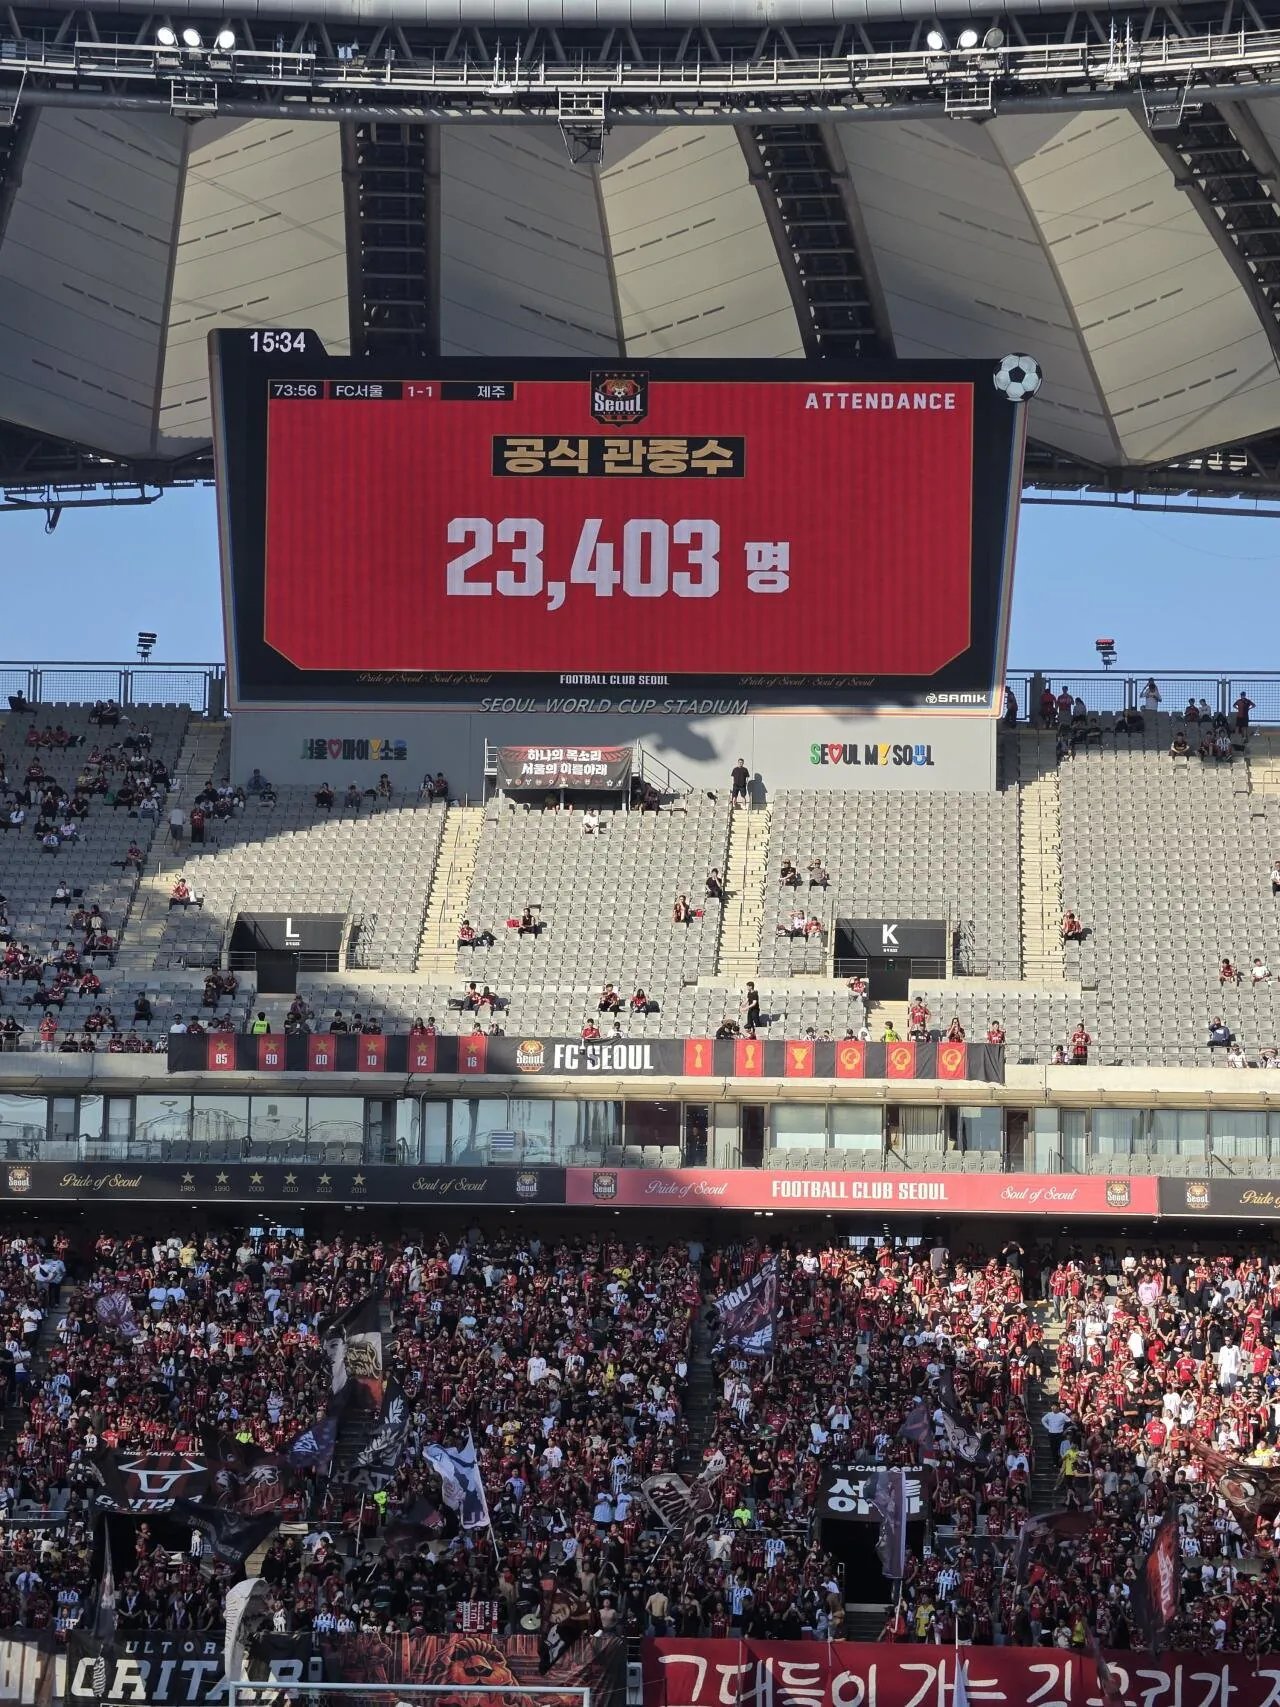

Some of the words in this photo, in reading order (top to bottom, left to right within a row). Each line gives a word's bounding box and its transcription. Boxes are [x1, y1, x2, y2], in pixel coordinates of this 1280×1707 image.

[250, 331, 306, 353] 15:34
[274, 384, 317, 398] 73:56
[335, 384, 384, 399] FC서울
[408, 386, 434, 398] 1-1
[477, 384, 506, 399] 제주
[805, 393, 956, 410] ATTENDANCE
[503, 438, 589, 474] 공식
[602, 439, 734, 475] 관중수
[446, 517, 721, 611] 23,403
[744, 541, 790, 593] 명
[560, 674, 608, 686] FOOTBALL
[610, 675, 636, 686] CLUB
[638, 675, 670, 686] SEOUL
[479, 698, 537, 713] SEOUL
[545, 698, 611, 714] WORLD
[617, 699, 657, 714] CUP
[661, 700, 749, 715] STADIUM
[938, 694, 987, 704] SAMIK
[527, 749, 563, 761] 하나의
[566, 749, 602, 761] 목소리
[521, 763, 557, 775] 서울의
[286, 918, 300, 938] L
[882, 924, 899, 945] K
[216, 1053, 228, 1065] 85
[265, 1053, 278, 1065] 90
[316, 1054, 328, 1065] 00
[367, 1055, 378, 1066] 10
[417, 1055, 427, 1067] 12
[467, 1056, 477, 1067] 16
[553, 1044, 579, 1069] FC
[587, 1044, 654, 1070] SEOUL
[59, 1172, 93, 1187] Pride
[93, 1175, 106, 1190] of
[109, 1173, 142, 1187] Seoul
[412, 1177, 438, 1191] Soul
[440, 1178, 453, 1194] of
[454, 1177, 487, 1191] Seoul
[645, 1180, 678, 1194] Pride
[678, 1182, 693, 1198] of
[694, 1181, 728, 1195] Seoul
[771, 1180, 849, 1198] FOOTBALL
[852, 1181, 893, 1199] CLUB
[898, 1182, 949, 1200] SEOUL
[1001, 1186, 1026, 1199] Soul
[1028, 1187, 1043, 1204] of
[1044, 1187, 1078, 1200] Seoul
[1240, 1190, 1274, 1204] Pride
[125, 1640, 227, 1654] ULTOR
[657, 1653, 877, 1707] 그대들이
